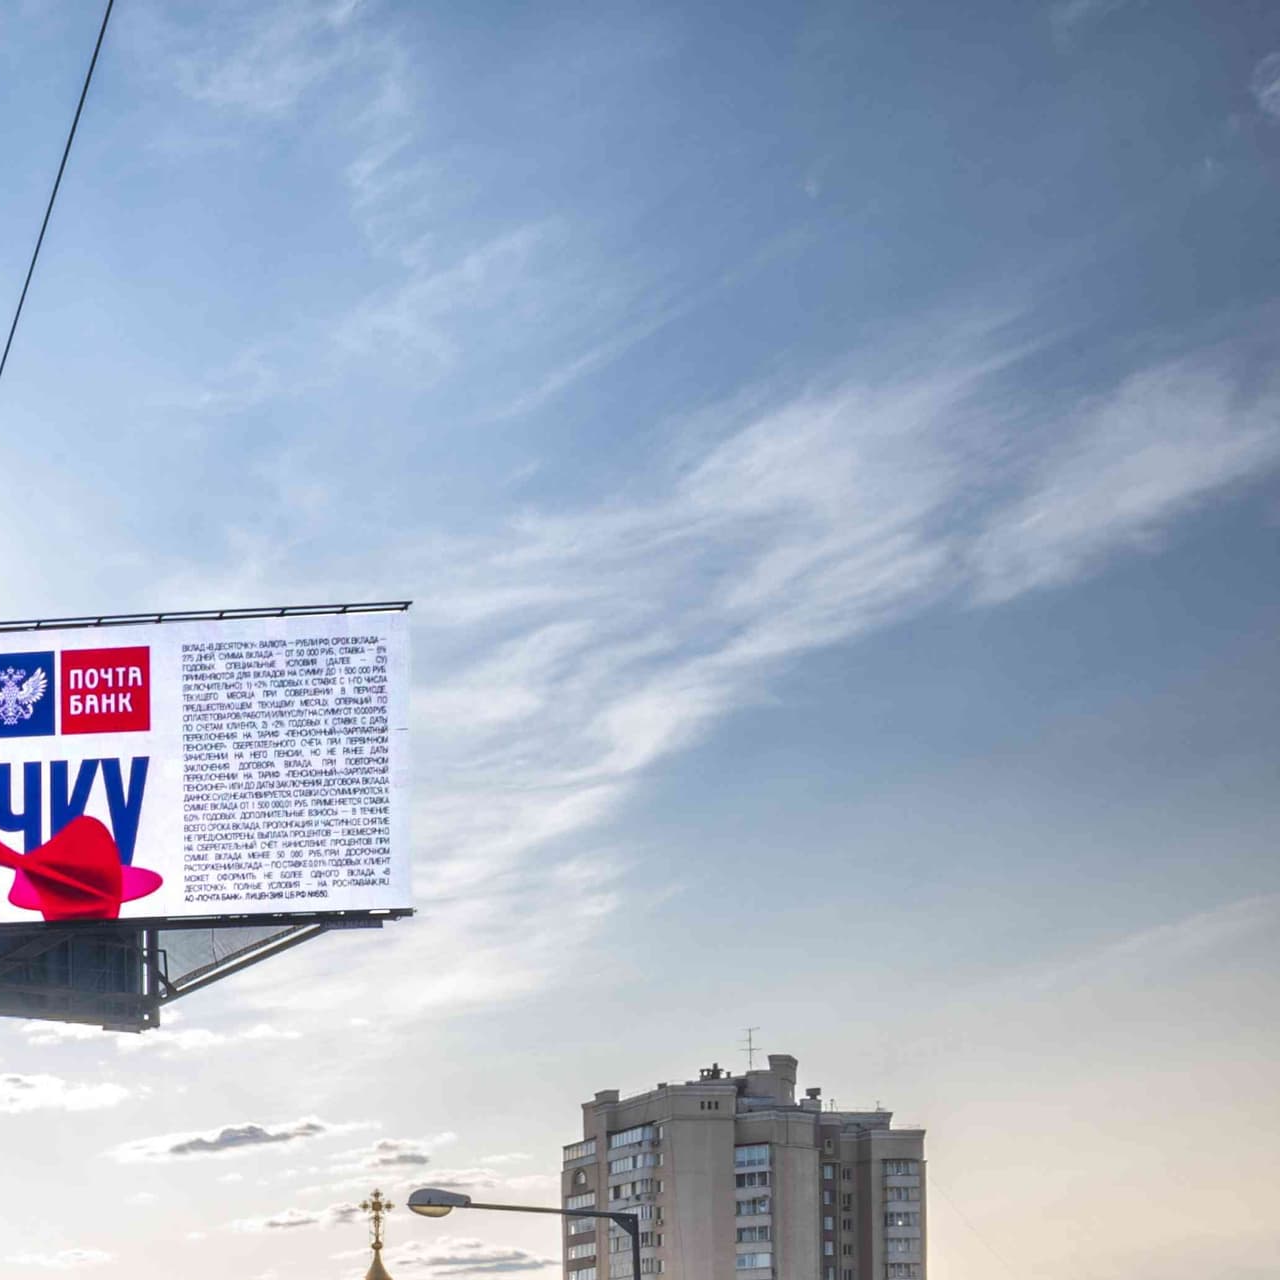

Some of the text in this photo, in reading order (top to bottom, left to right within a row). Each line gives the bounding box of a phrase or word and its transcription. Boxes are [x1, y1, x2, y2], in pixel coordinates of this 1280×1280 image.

[245, 650, 272, 660] ВКЛАДА
[69, 666, 143, 690] ПОЧТА
[262, 689, 277, 698] ПРИ
[69, 692, 133, 716] БАНК
[326, 737, 341, 745] ПРИ
[238, 760, 275, 770] ДОГОВОРА
[321, 757, 336, 766] ПРИ
[375, 836, 390, 844] ПРИ
